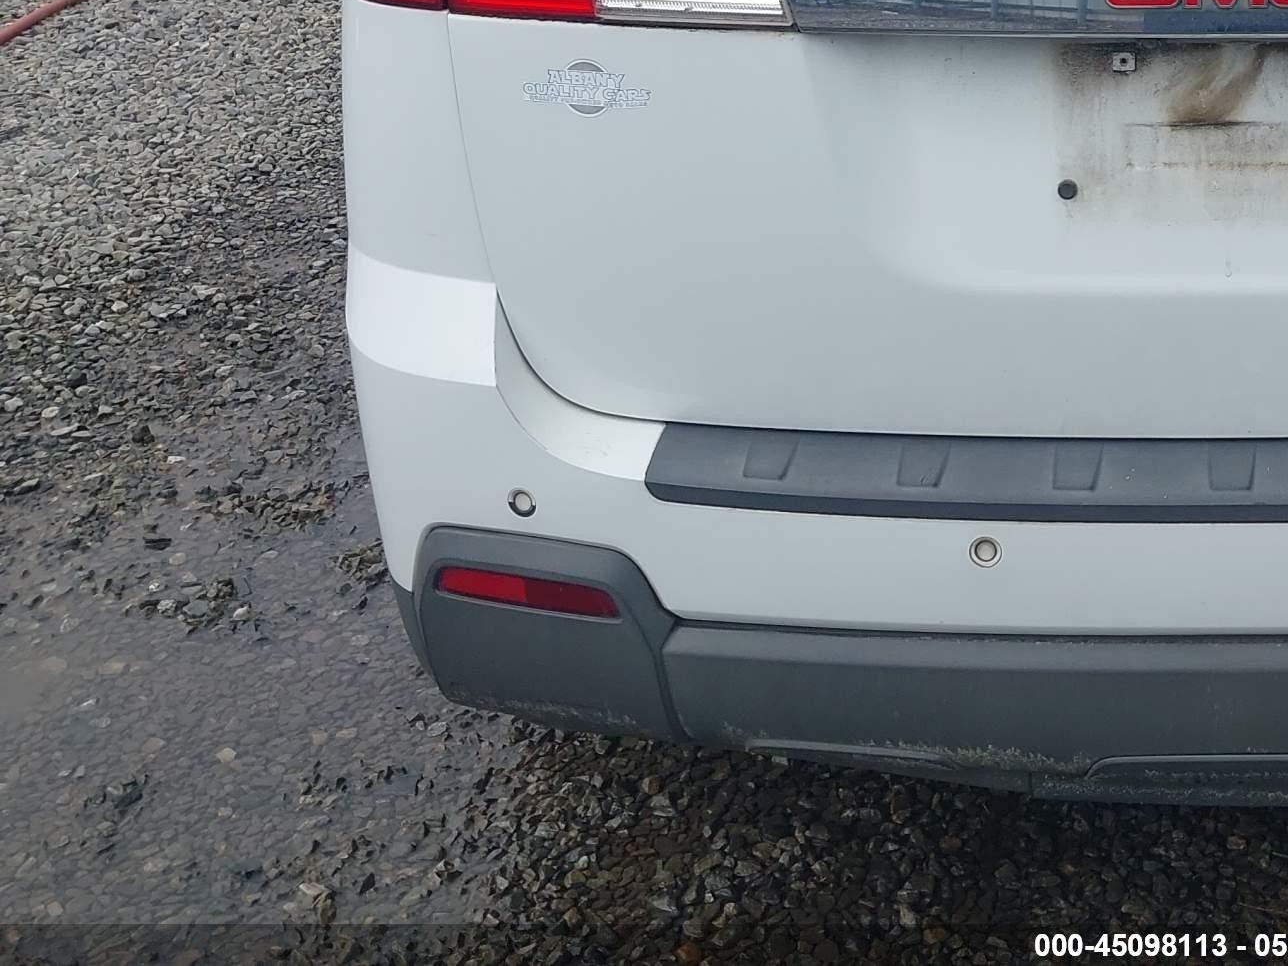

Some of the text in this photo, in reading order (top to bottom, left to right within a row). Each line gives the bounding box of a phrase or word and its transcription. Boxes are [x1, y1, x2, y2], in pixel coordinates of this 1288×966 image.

[547, 68, 625, 88] ALBANY
[522, 82, 600, 99] QUALITY
[602, 87, 651, 102] CARS
